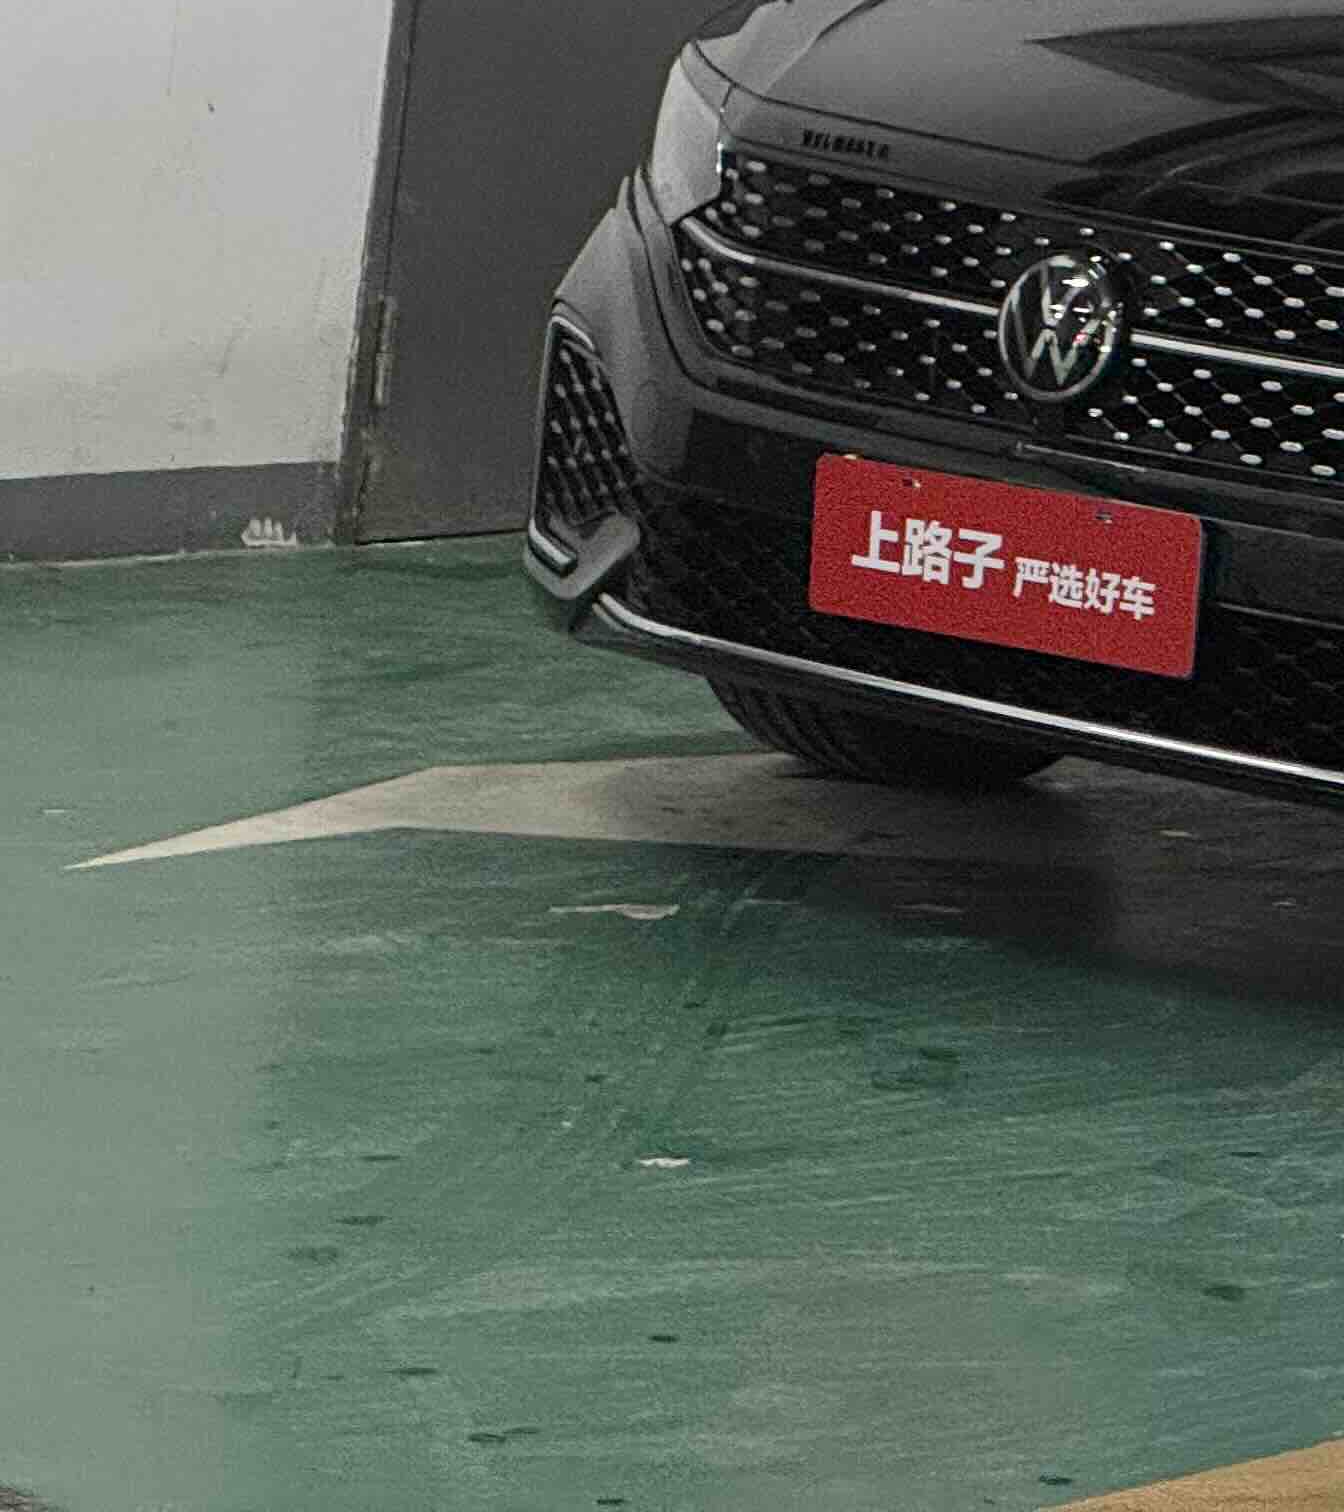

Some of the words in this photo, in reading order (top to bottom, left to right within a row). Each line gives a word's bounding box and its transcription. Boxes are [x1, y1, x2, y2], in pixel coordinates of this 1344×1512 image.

[851, 509, 1005, 590] 上路子
[1013, 556, 1156, 621] 严选好车
